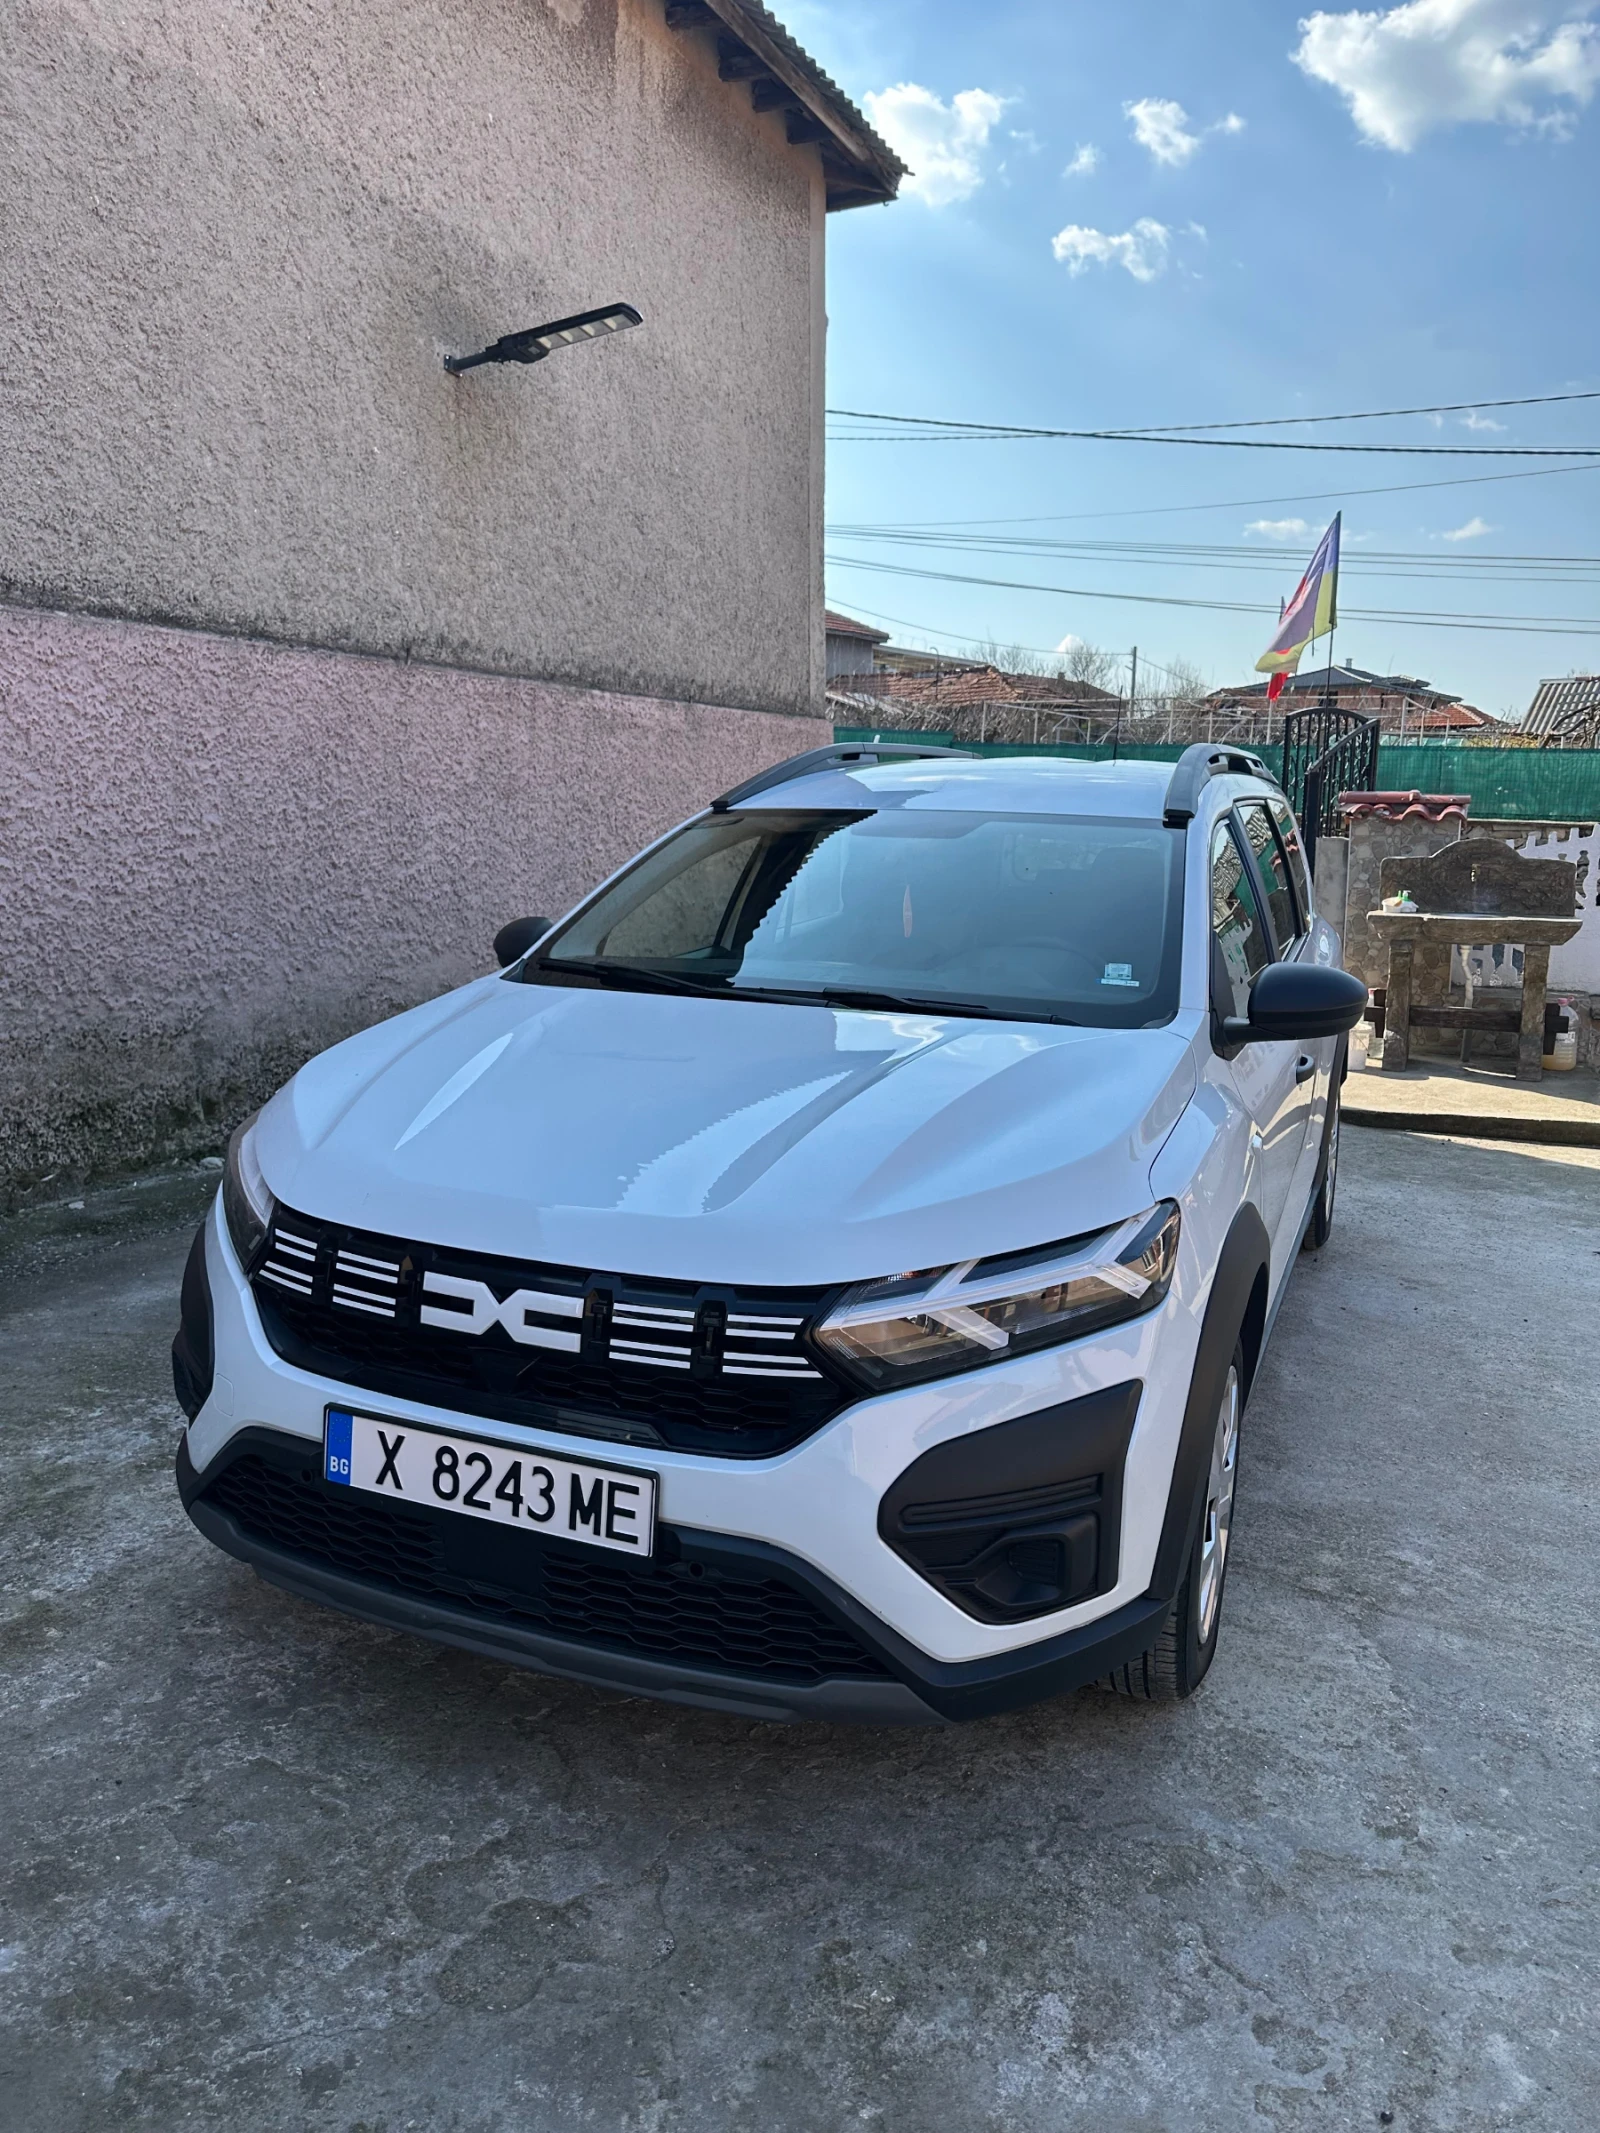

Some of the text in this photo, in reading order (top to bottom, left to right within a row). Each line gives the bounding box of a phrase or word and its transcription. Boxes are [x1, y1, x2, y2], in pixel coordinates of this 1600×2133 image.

[330, 1456, 349, 1475] BG
[375, 1430, 640, 1545] X 8243 ME
